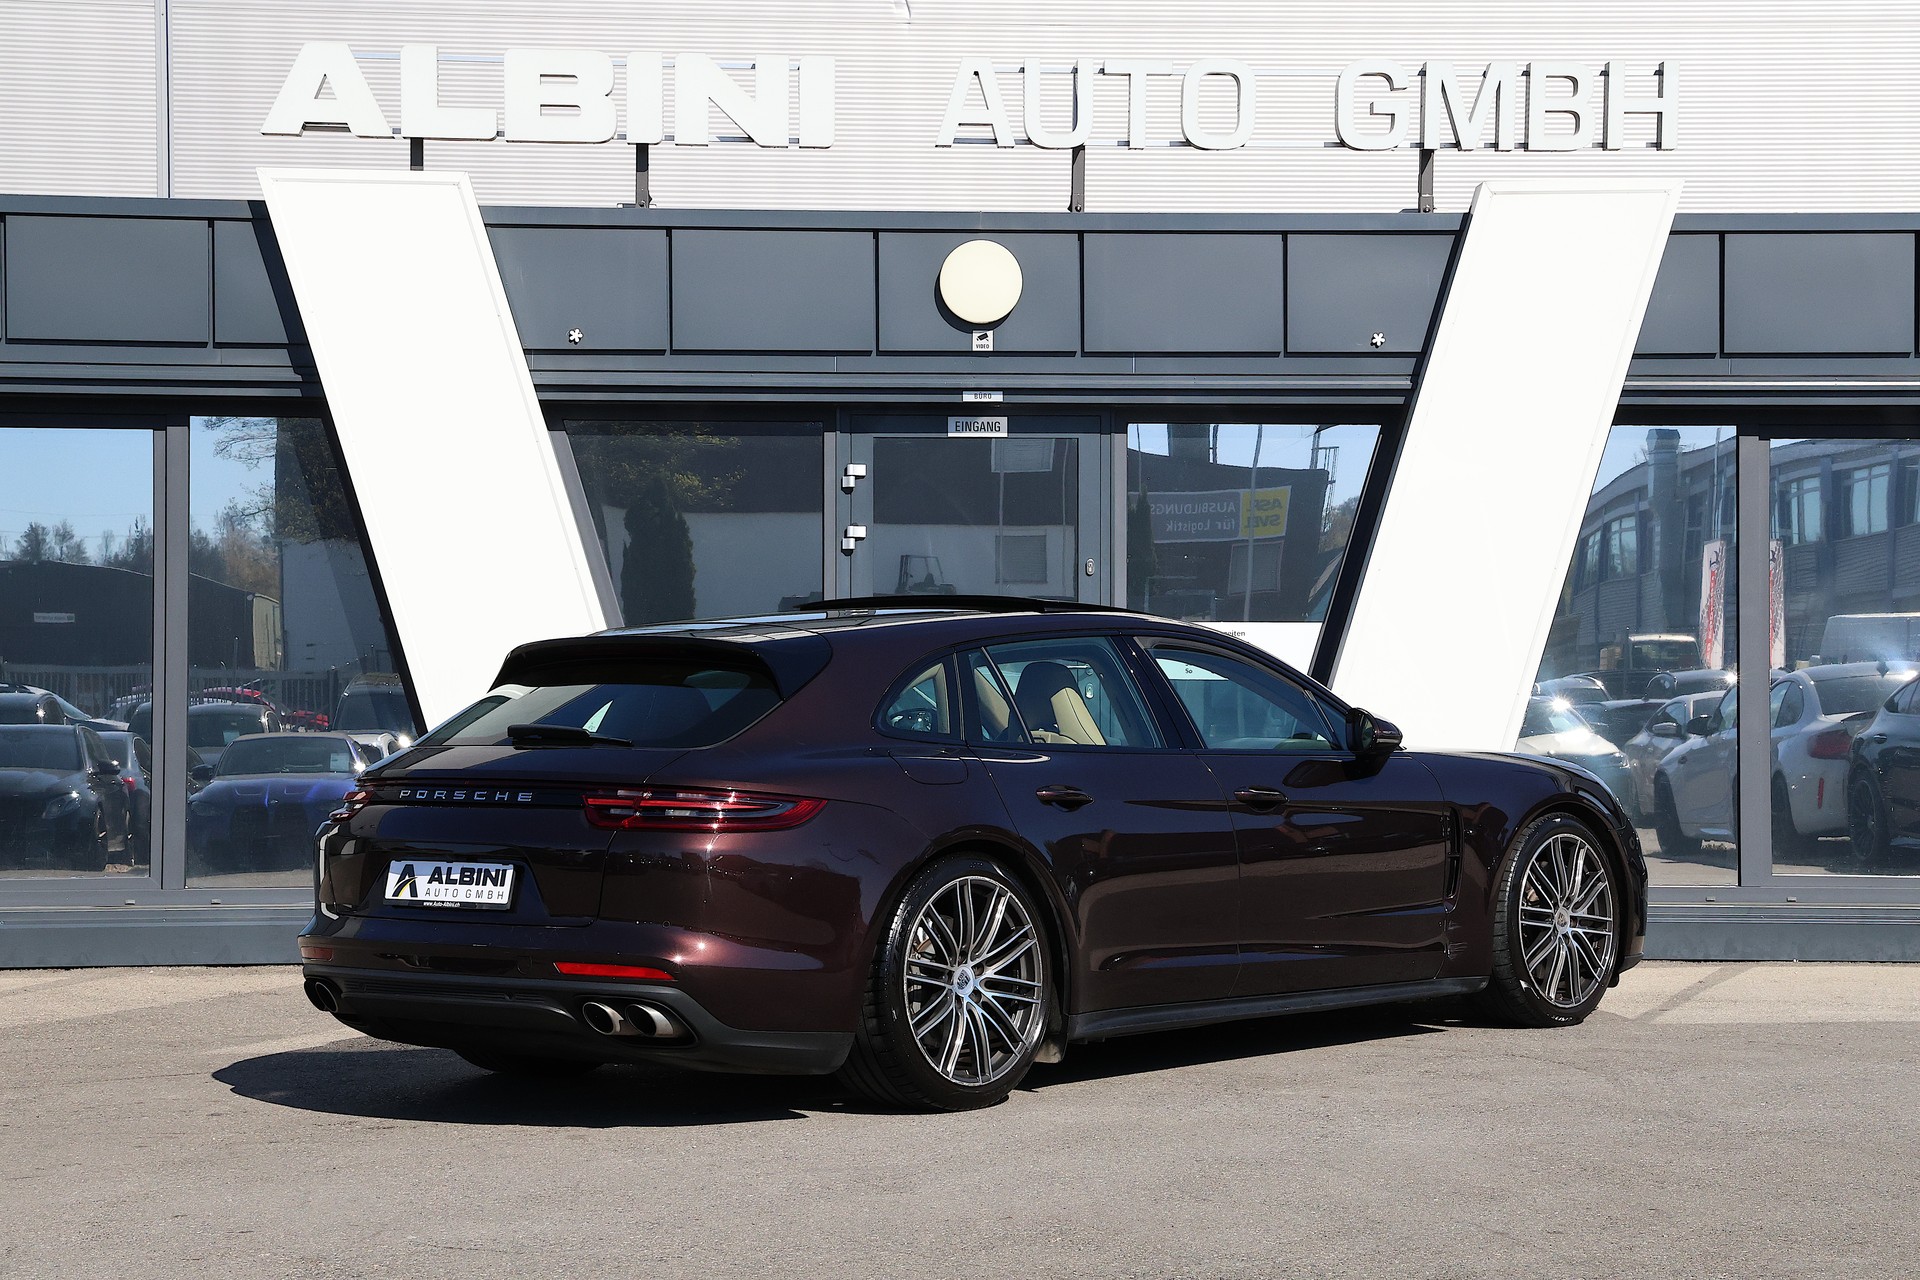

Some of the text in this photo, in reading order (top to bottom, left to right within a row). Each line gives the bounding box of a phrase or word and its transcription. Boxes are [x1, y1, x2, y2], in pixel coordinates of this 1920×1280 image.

[259, 41, 1682, 152] ALBINI AUTO GMBH
[973, 392, 992, 400] BÜRO
[955, 421, 1001, 432] EINGANG
[400, 790, 533, 802] PORSCHE
[427, 866, 508, 887] ALBINI
[425, 888, 504, 900] AUTO GMBH
